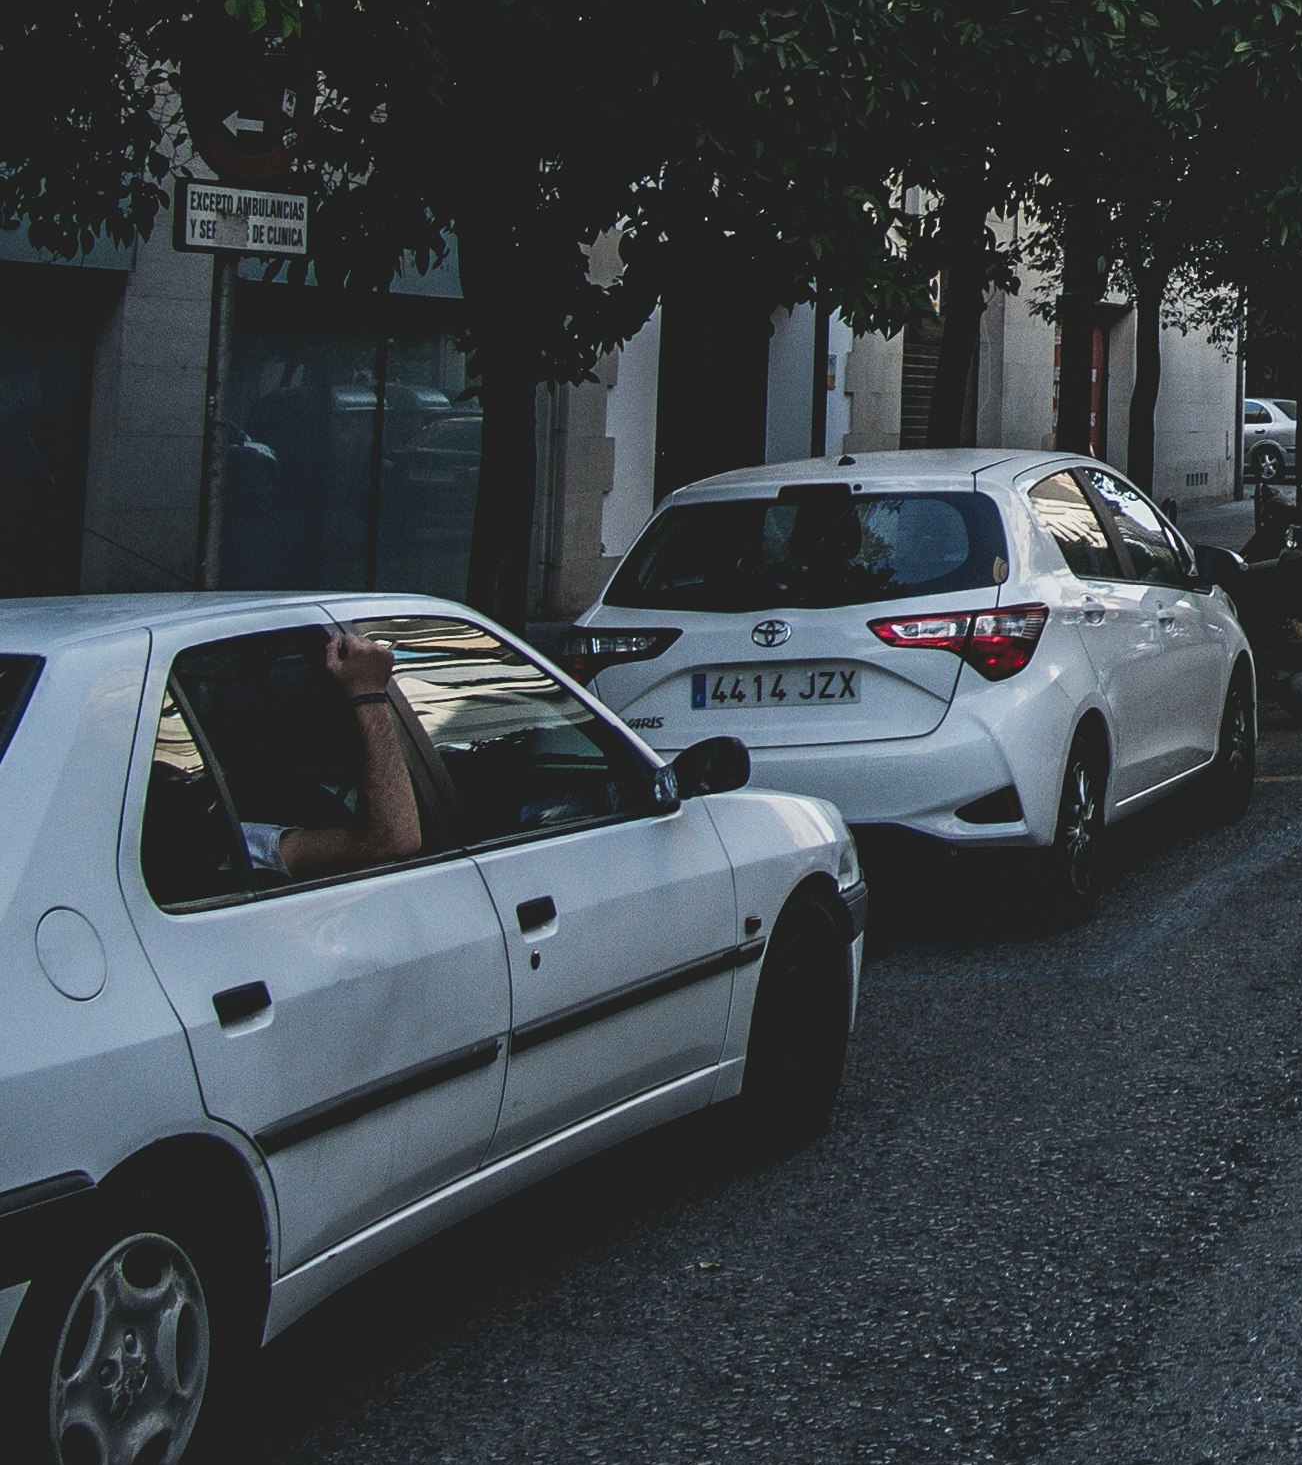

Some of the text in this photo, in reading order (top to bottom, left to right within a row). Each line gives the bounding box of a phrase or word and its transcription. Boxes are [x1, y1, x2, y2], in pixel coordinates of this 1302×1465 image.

[190, 191, 304, 220] EXCEPTO AMBULANCIAS
[190, 219, 197, 239] Y
[253, 224, 265, 243] DE
[267, 225, 304, 247] CLINICA
[711, 673, 786, 703] 4414
[799, 671, 856, 700] JZX
